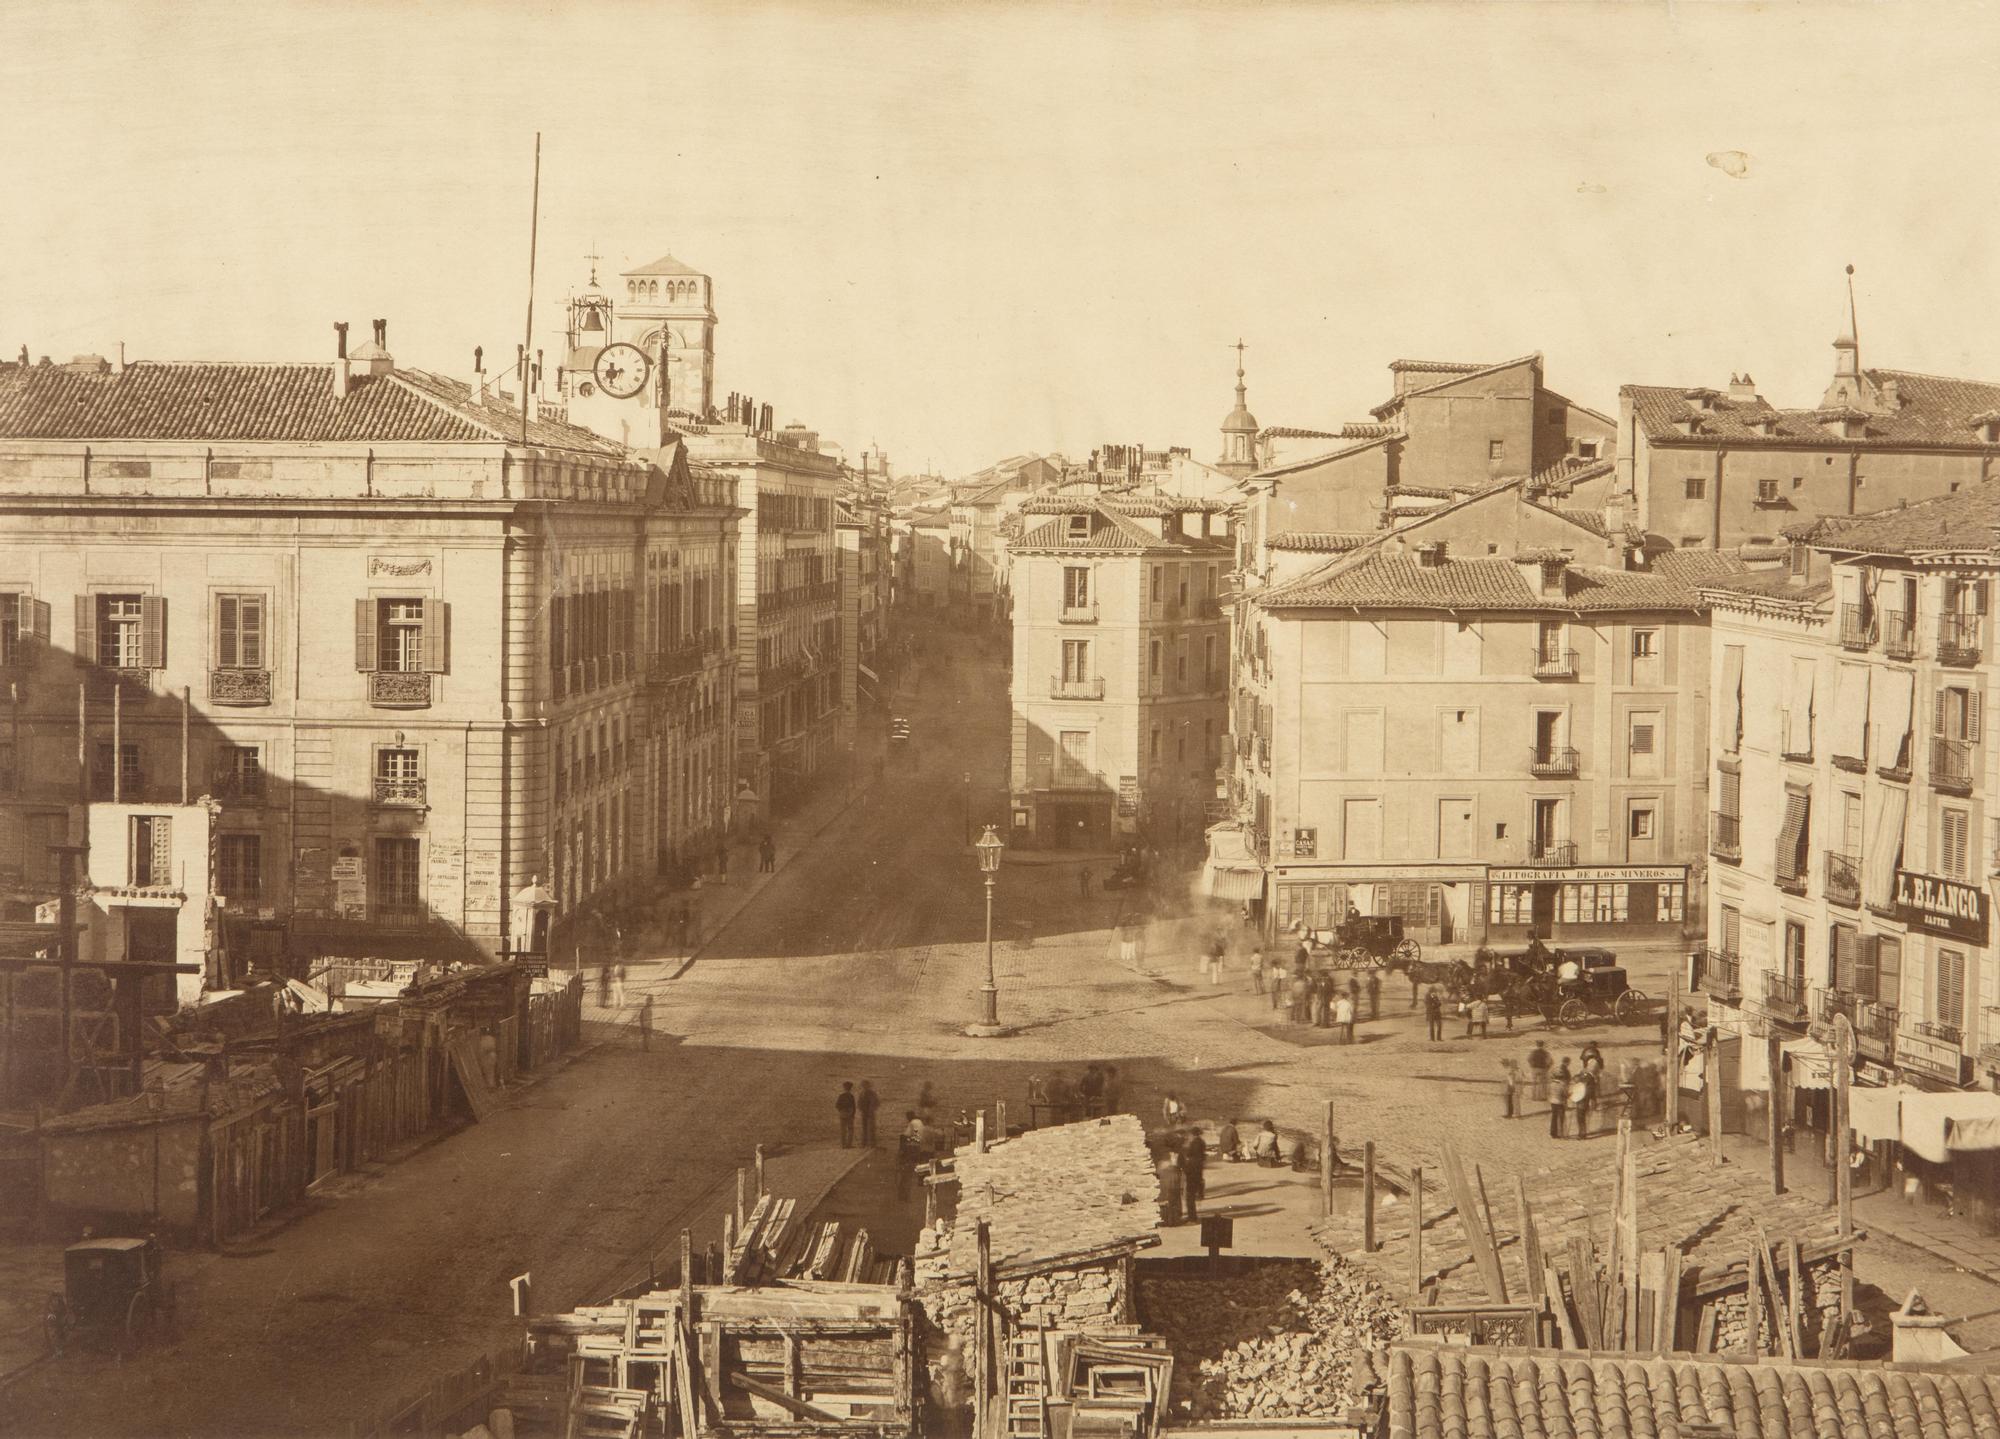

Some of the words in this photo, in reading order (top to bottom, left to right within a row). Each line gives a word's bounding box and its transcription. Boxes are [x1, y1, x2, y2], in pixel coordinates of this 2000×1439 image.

[1502, 871, 1566, 879] LITOGRAFIA
[1576, 871, 1590, 879] DE
[1596, 871, 1616, 879] LOS
[1620, 870, 1666, 878] MINEROS
